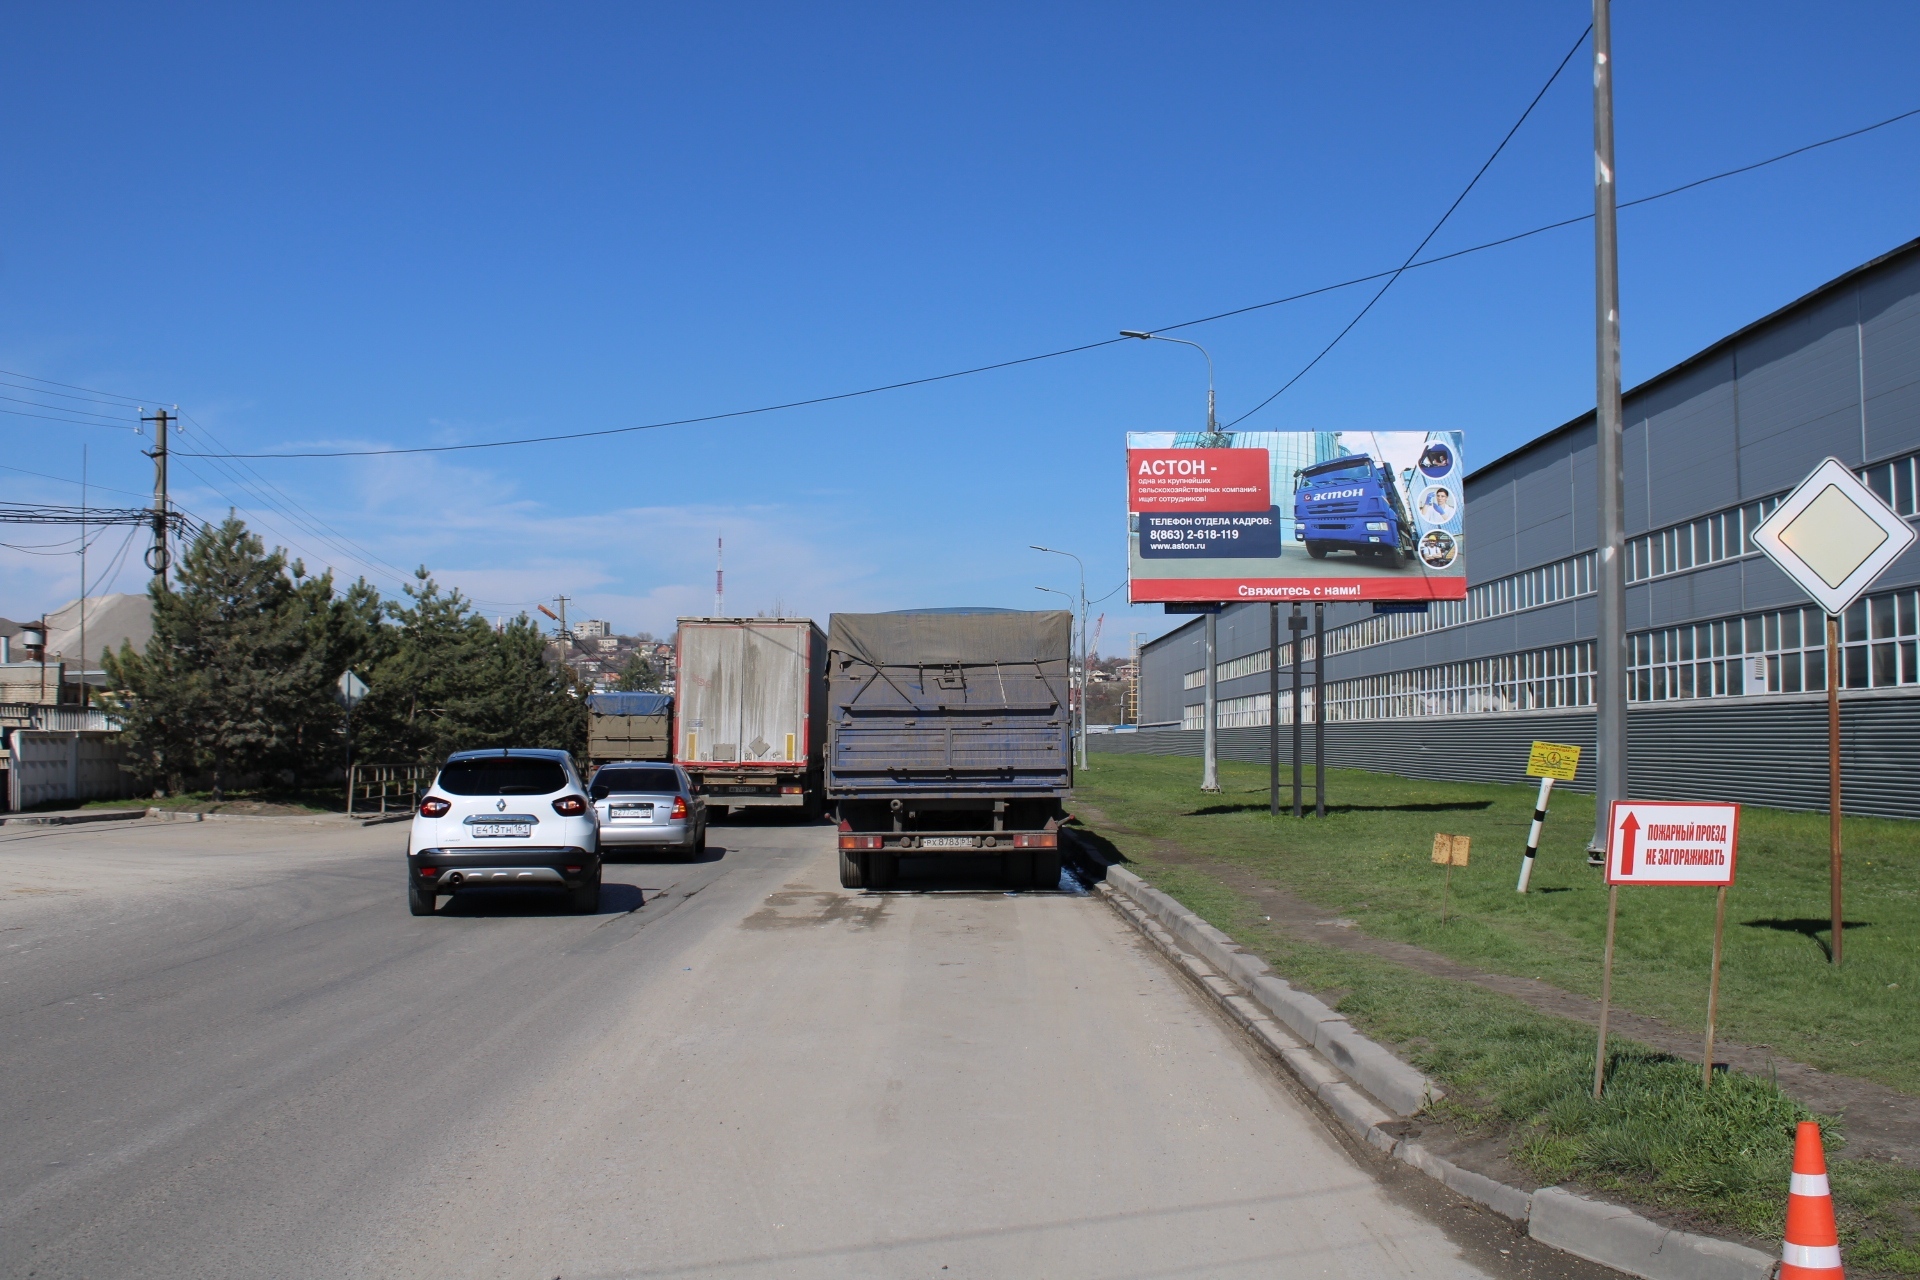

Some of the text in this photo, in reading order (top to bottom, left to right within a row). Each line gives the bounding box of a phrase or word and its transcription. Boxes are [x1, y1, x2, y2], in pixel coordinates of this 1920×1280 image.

[1138, 459, 1206, 475] АСТОН
[1167, 477, 1211, 486] крупнейших
[1158, 495, 1207, 504] сотрудников!
[1150, 518, 1272, 527] ТЕЛЕФОН ОТДЕЛА КАДРОВ:
[1150, 529, 1239, 542] 8(863) 2-618-119
[1238, 584, 1361, 597] Свяжитесь с нами!
[1647, 821, 1727, 844] ПОЖАРНЫЙ ПРОЕЗД
[1645, 848, 1725, 867] НЕ ЗАГОРАЖИВАТЬ
